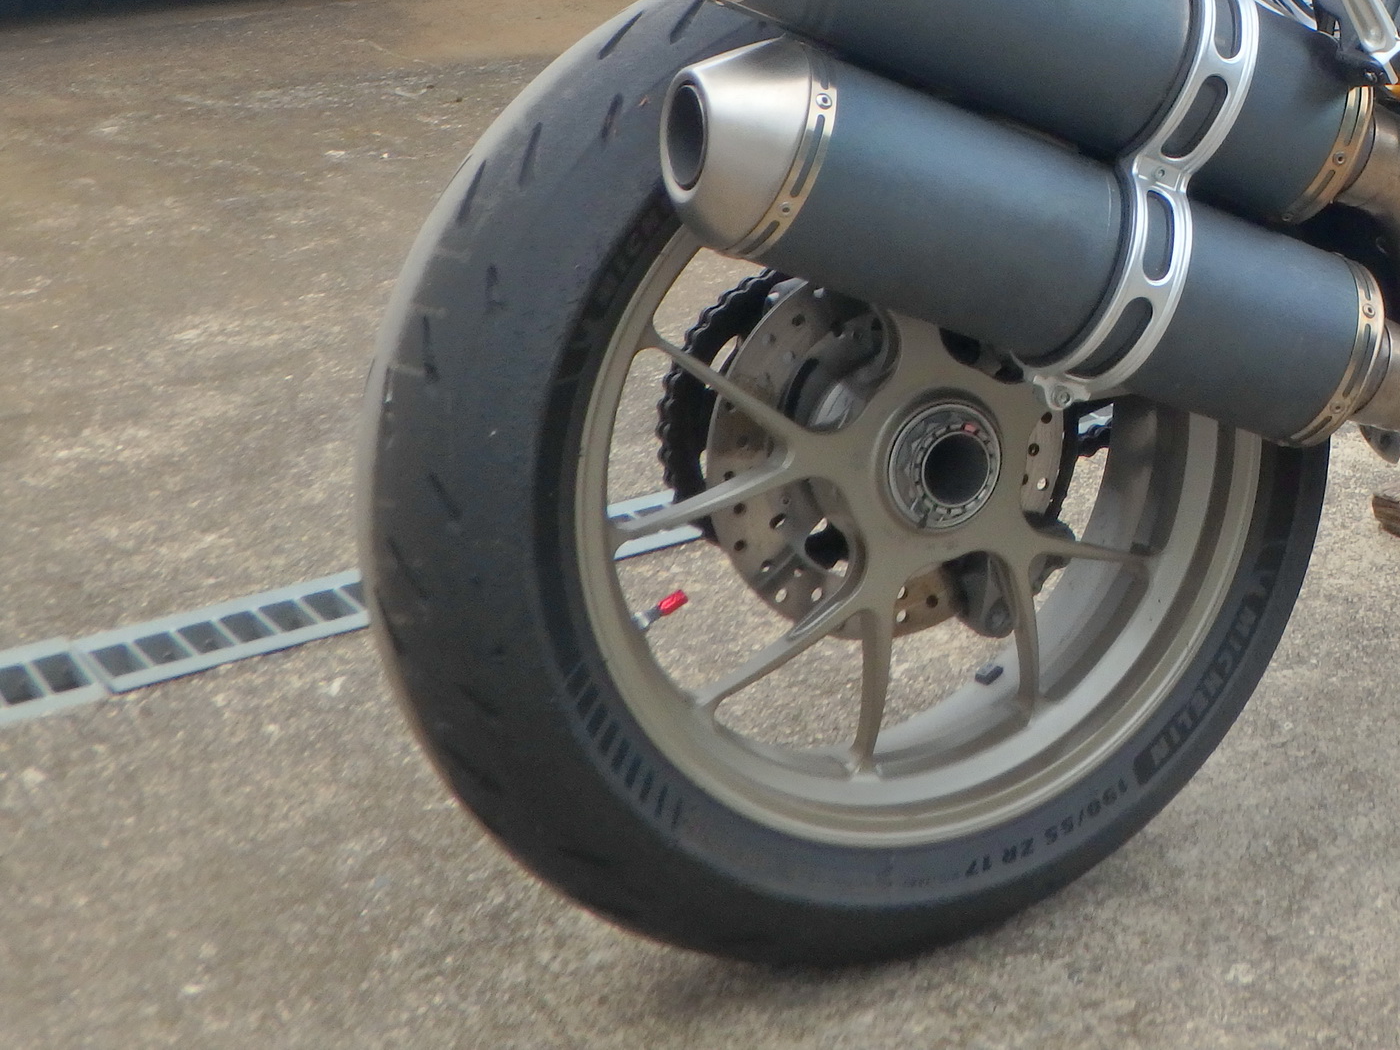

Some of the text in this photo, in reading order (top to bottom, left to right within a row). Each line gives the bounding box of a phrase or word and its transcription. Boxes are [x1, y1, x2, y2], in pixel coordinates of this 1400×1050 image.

[1144, 600, 1260, 772] MICHELIN
[1001, 837, 1035, 865] ZR
[964, 854, 993, 878] 17
